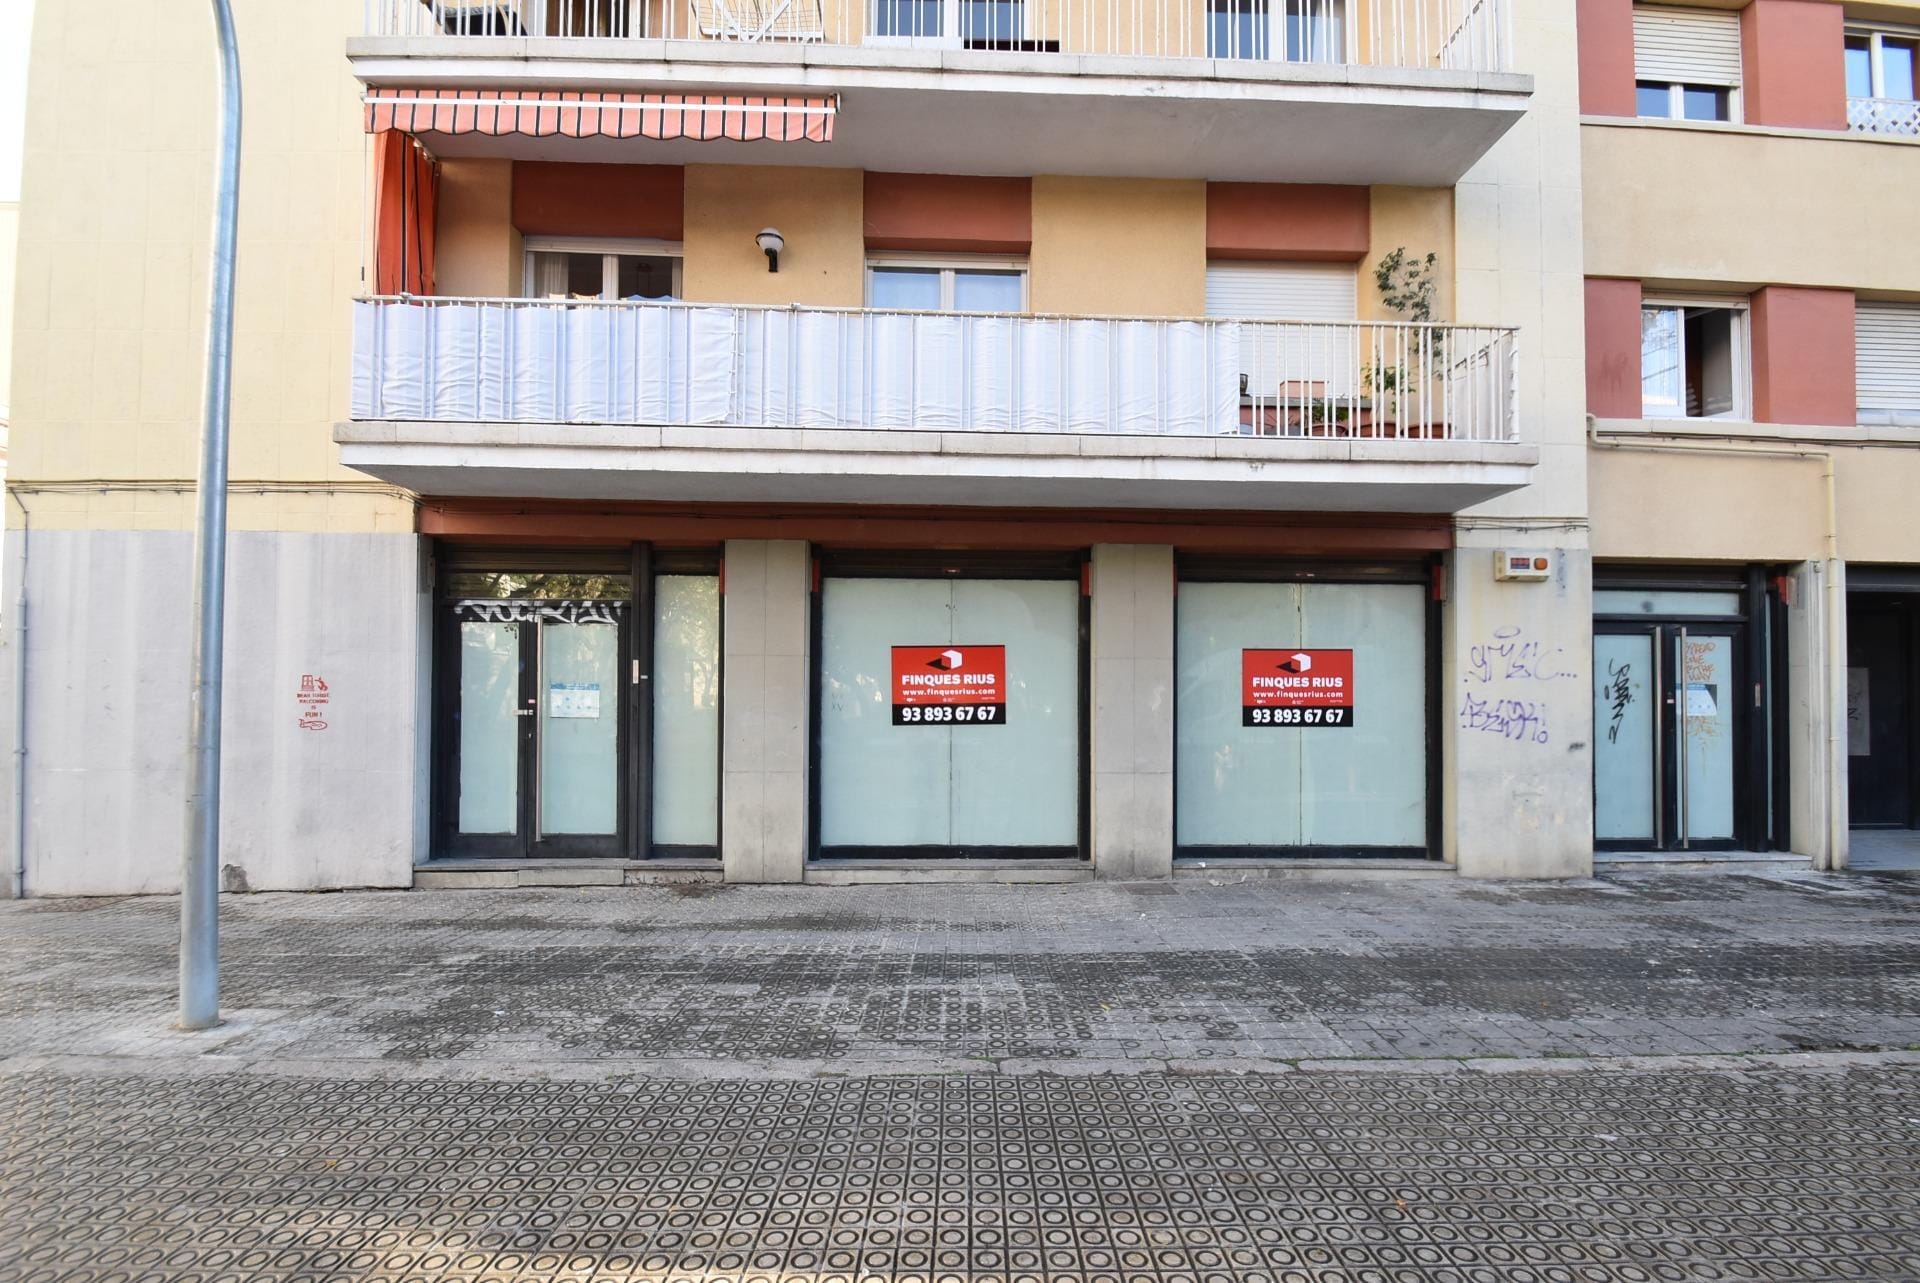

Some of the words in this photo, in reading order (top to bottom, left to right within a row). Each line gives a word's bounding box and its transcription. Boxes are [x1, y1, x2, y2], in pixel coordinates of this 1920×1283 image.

[902, 674, 961, 686] FINQUES
[963, 674, 996, 685] RIUS
[1252, 677, 1310, 689] FINQUES
[1312, 677, 1344, 688] RIUS
[902, 688, 996, 696] www.finquesrius.com
[1253, 691, 1344, 699] www.finquesrius.com
[902, 707, 921, 722] 93
[924, 707, 953, 722] 893
[955, 706, 975, 721] 67
[977, 706, 996, 721] 67
[1252, 709, 1271, 724] 93
[1274, 709, 1301, 723] 893
[1304, 709, 1322, 723] 67
[1325, 709, 1344, 723] 67
